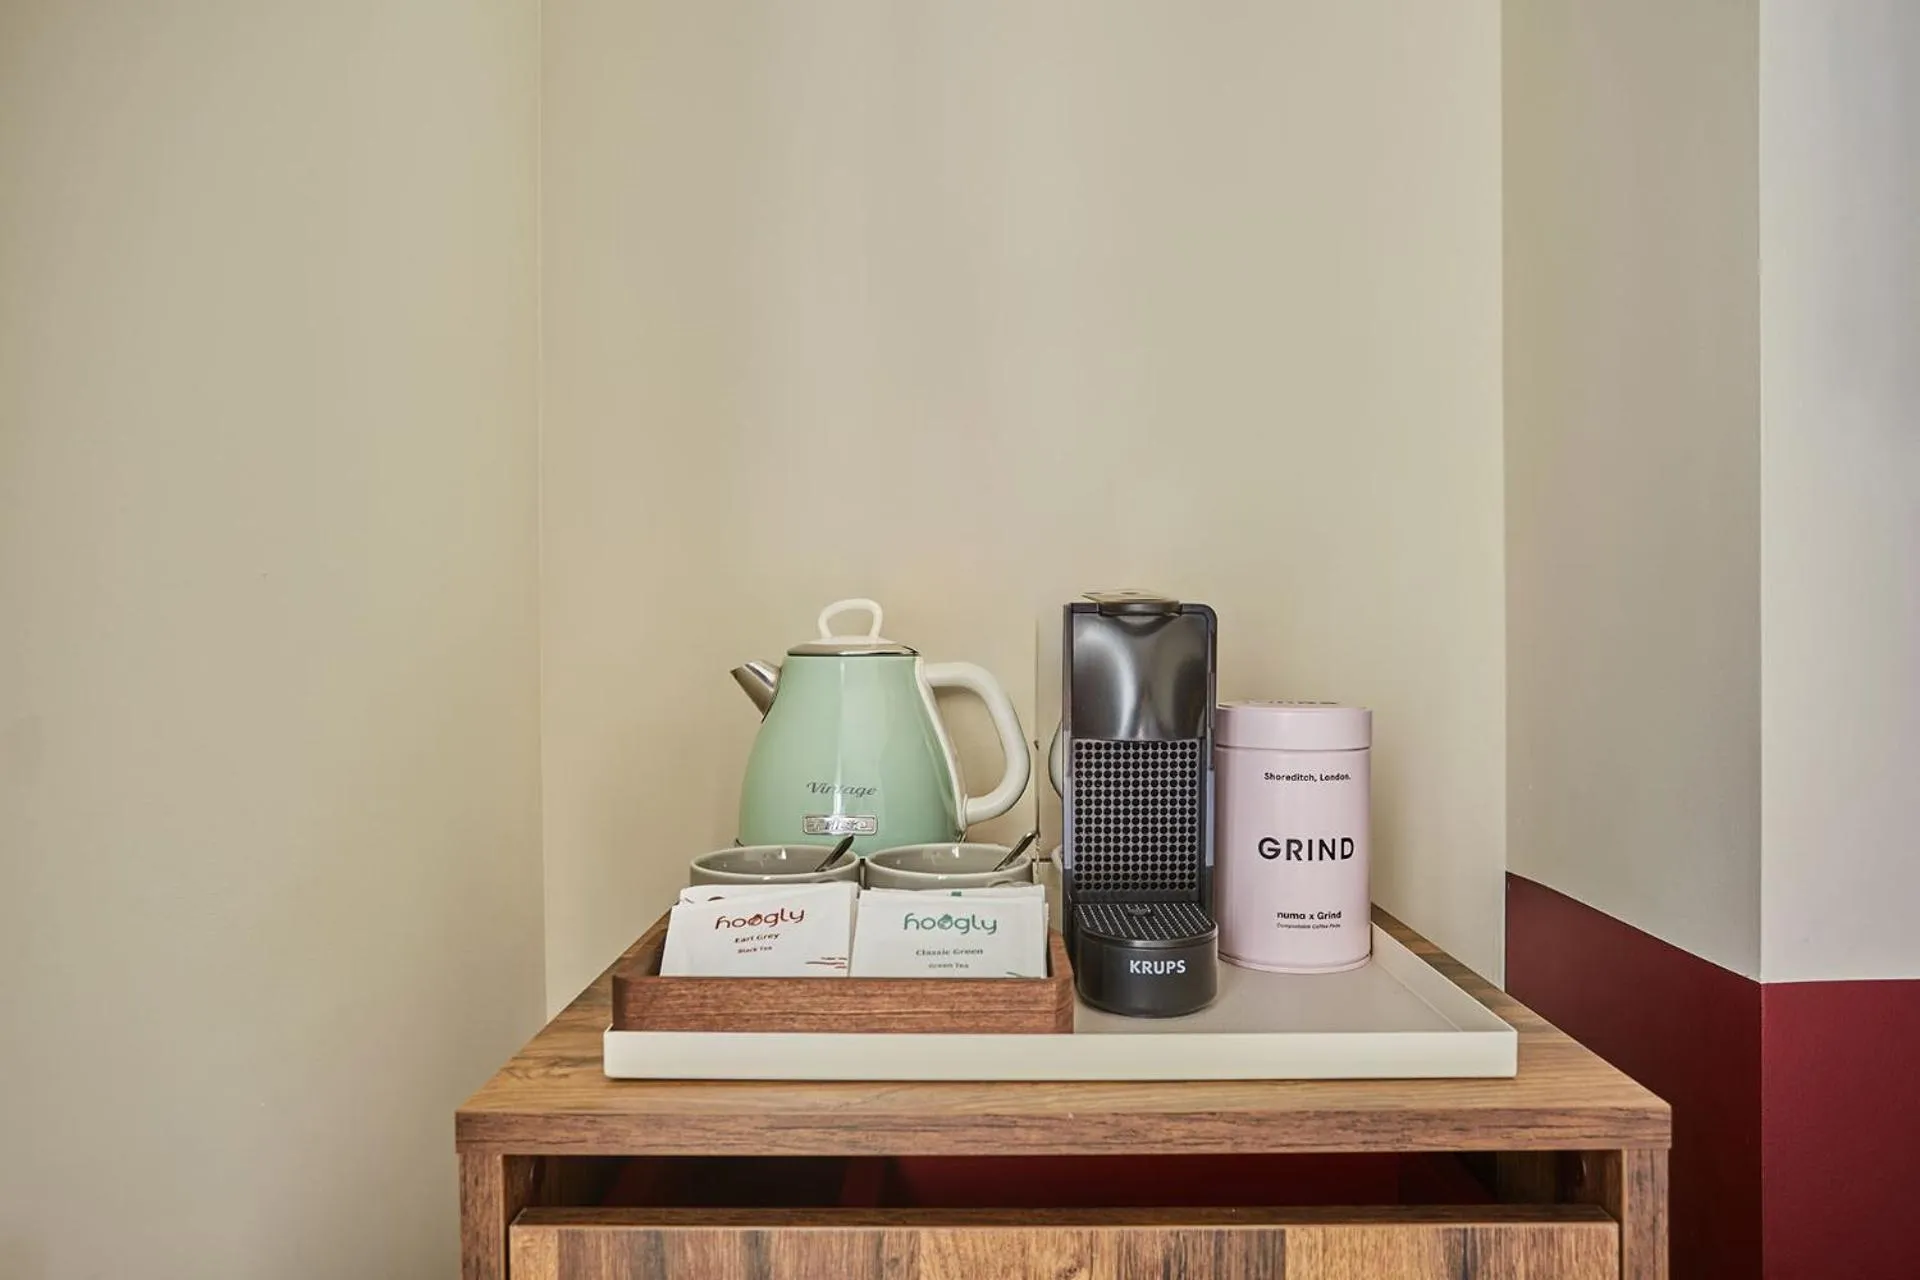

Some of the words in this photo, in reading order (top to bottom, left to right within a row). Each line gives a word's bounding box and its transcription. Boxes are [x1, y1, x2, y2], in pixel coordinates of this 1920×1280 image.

[1264, 772, 1317, 782] Shoreditch,
[1320, 773, 1351, 781] London.
[806, 782, 878, 798] Vinage
[1258, 837, 1354, 861] GRIND
[715, 908, 805, 929] hoogly
[1276, 911, 1306, 920] numa
[1316, 910, 1342, 920] Grind
[904, 912, 997, 935] hoogly
[1129, 959, 1187, 975] KRUPS
